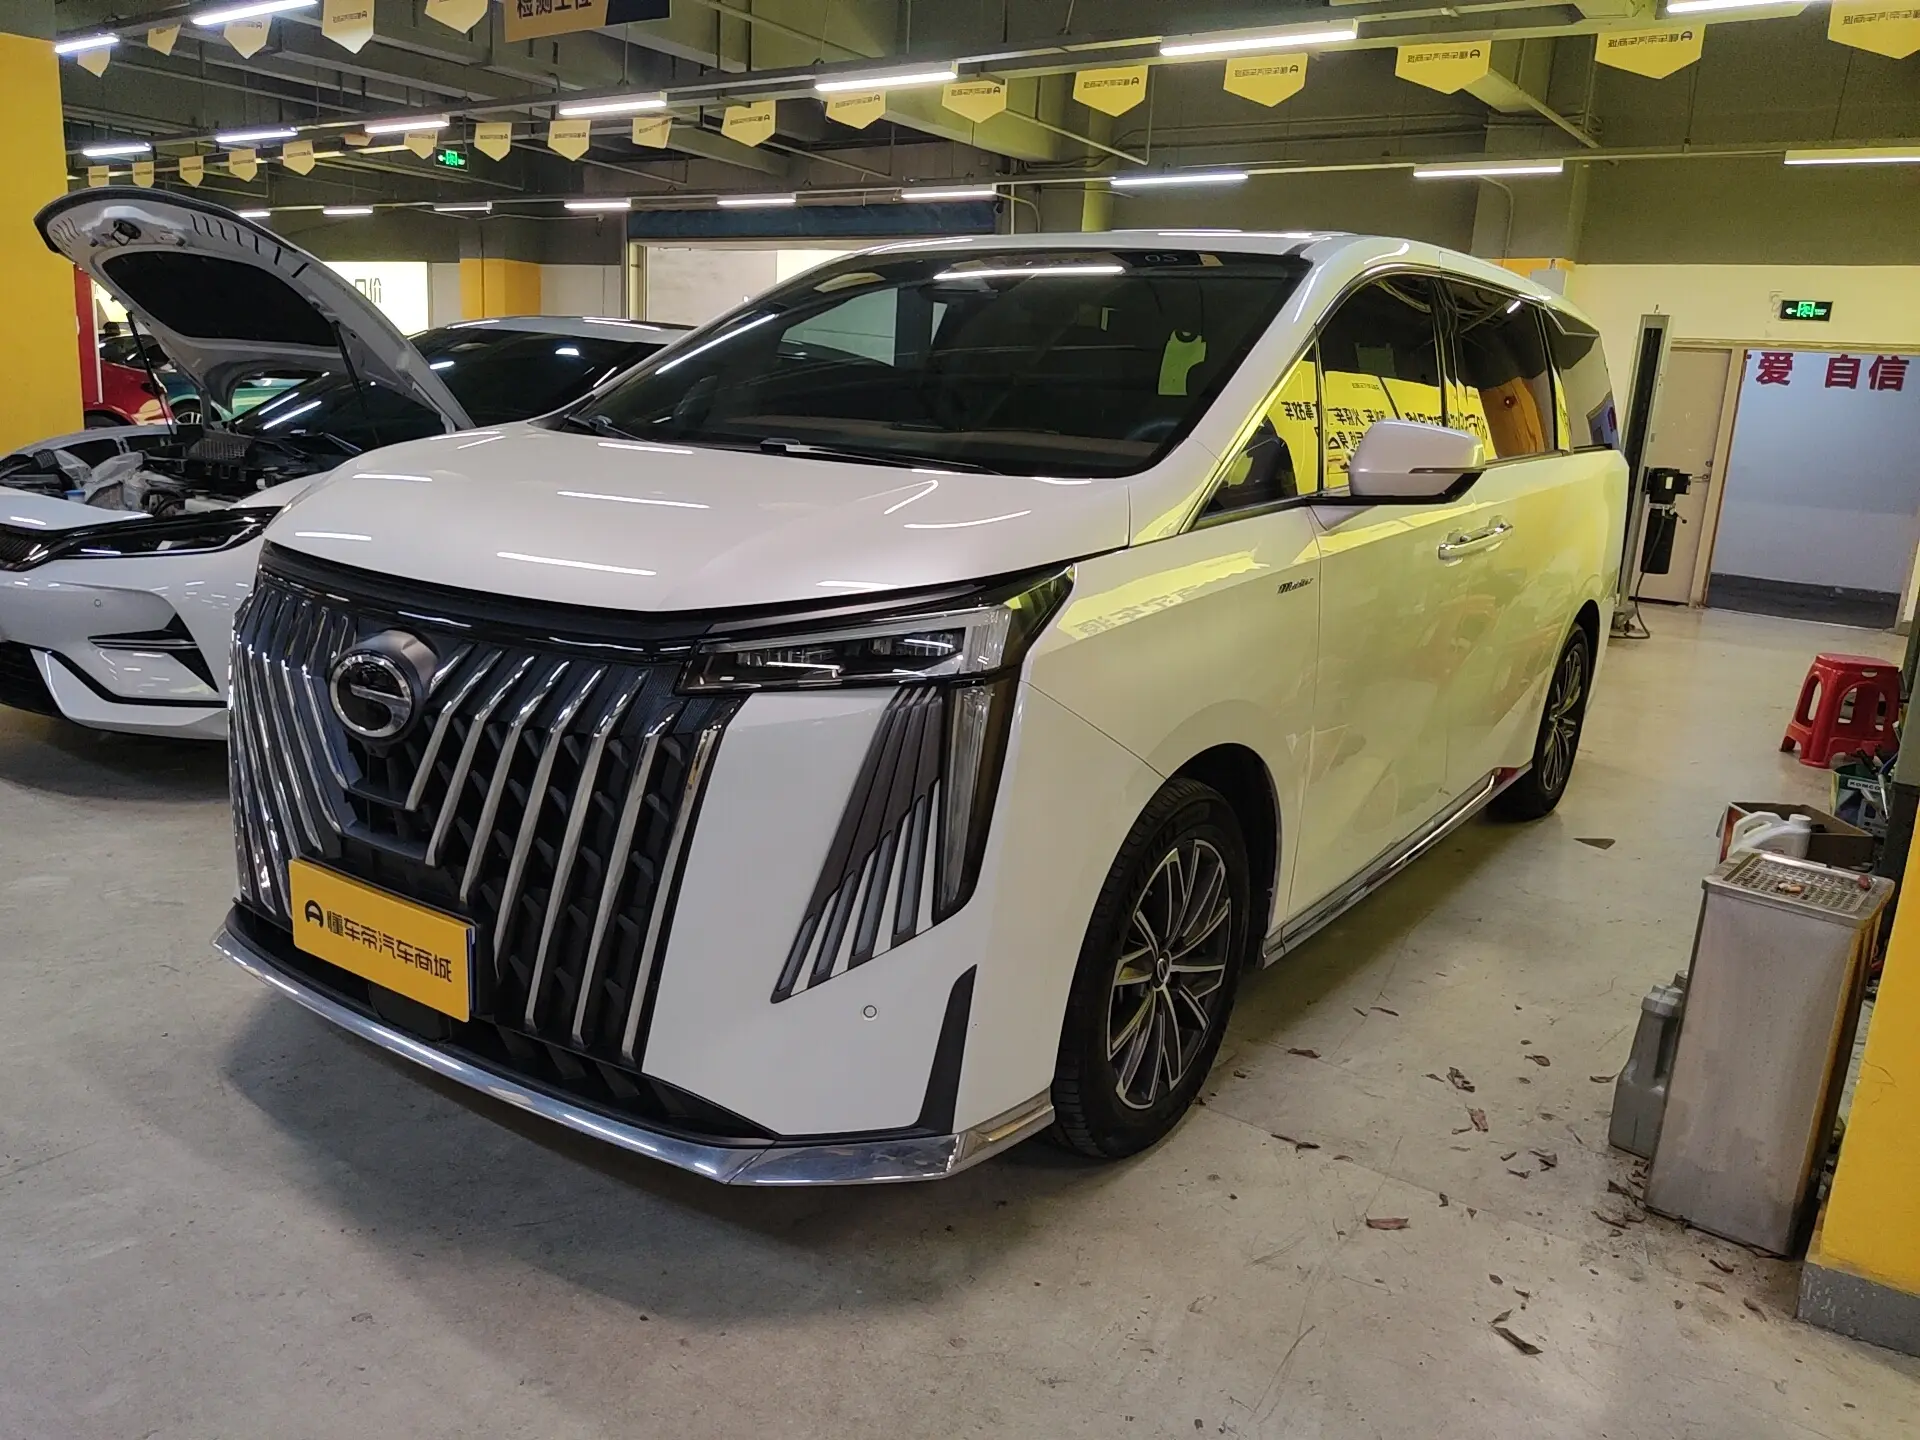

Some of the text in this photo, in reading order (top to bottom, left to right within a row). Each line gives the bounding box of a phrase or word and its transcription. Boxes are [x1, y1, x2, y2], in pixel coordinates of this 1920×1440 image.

[1747, 351, 1910, 392] 爱 自信
[326, 909, 453, 983] 懂车帝汽车商城
